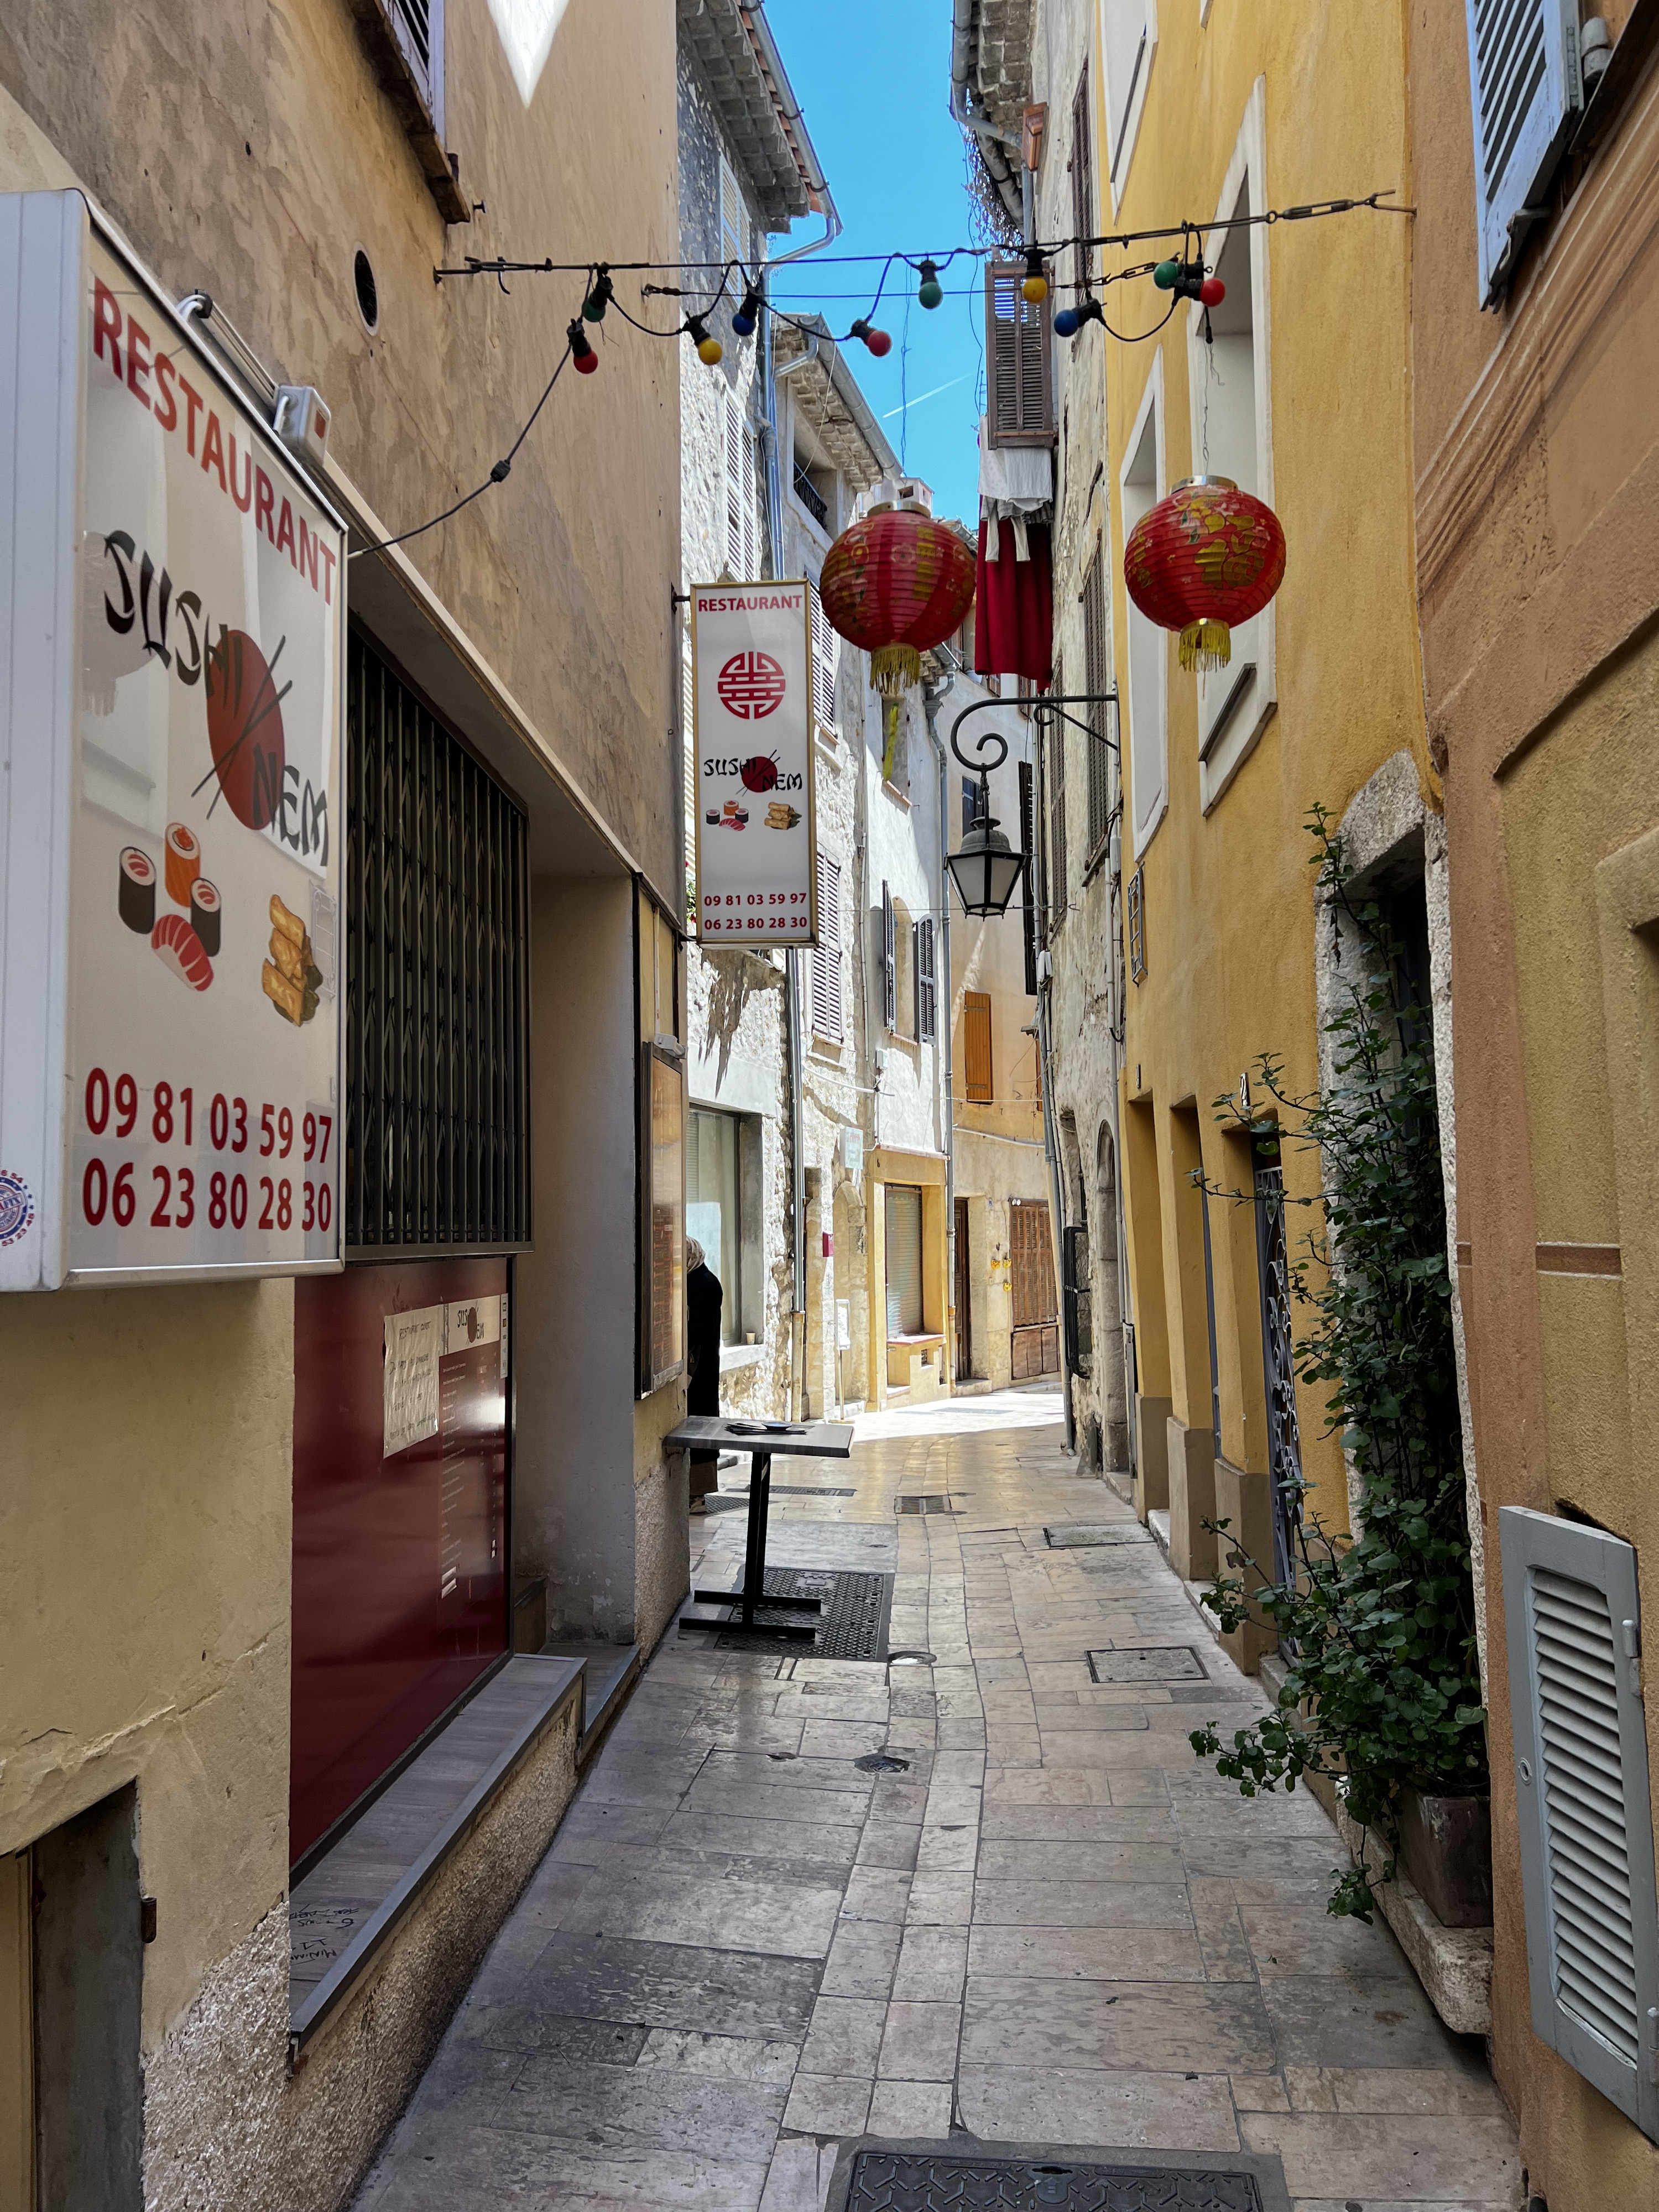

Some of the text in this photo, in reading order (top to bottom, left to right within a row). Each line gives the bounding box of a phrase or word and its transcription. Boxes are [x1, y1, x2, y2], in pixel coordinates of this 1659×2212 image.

[93, 274, 336, 606] RESTAURANT
[104, 529, 243, 719] SUSHI
[698, 595, 803, 613] RESTAURANT
[703, 758, 757, 776] SUSHI
[761, 773, 803, 792] NEM
[253, 742, 328, 867] NEM
[704, 893, 807, 906] 09 81 03 59 97
[704, 917, 807, 930] 06 23 80 28 30
[85, 1067, 332, 1163] 09 81 03 59 97
[83, 1158, 331, 1232] 06 23 80 28 30
